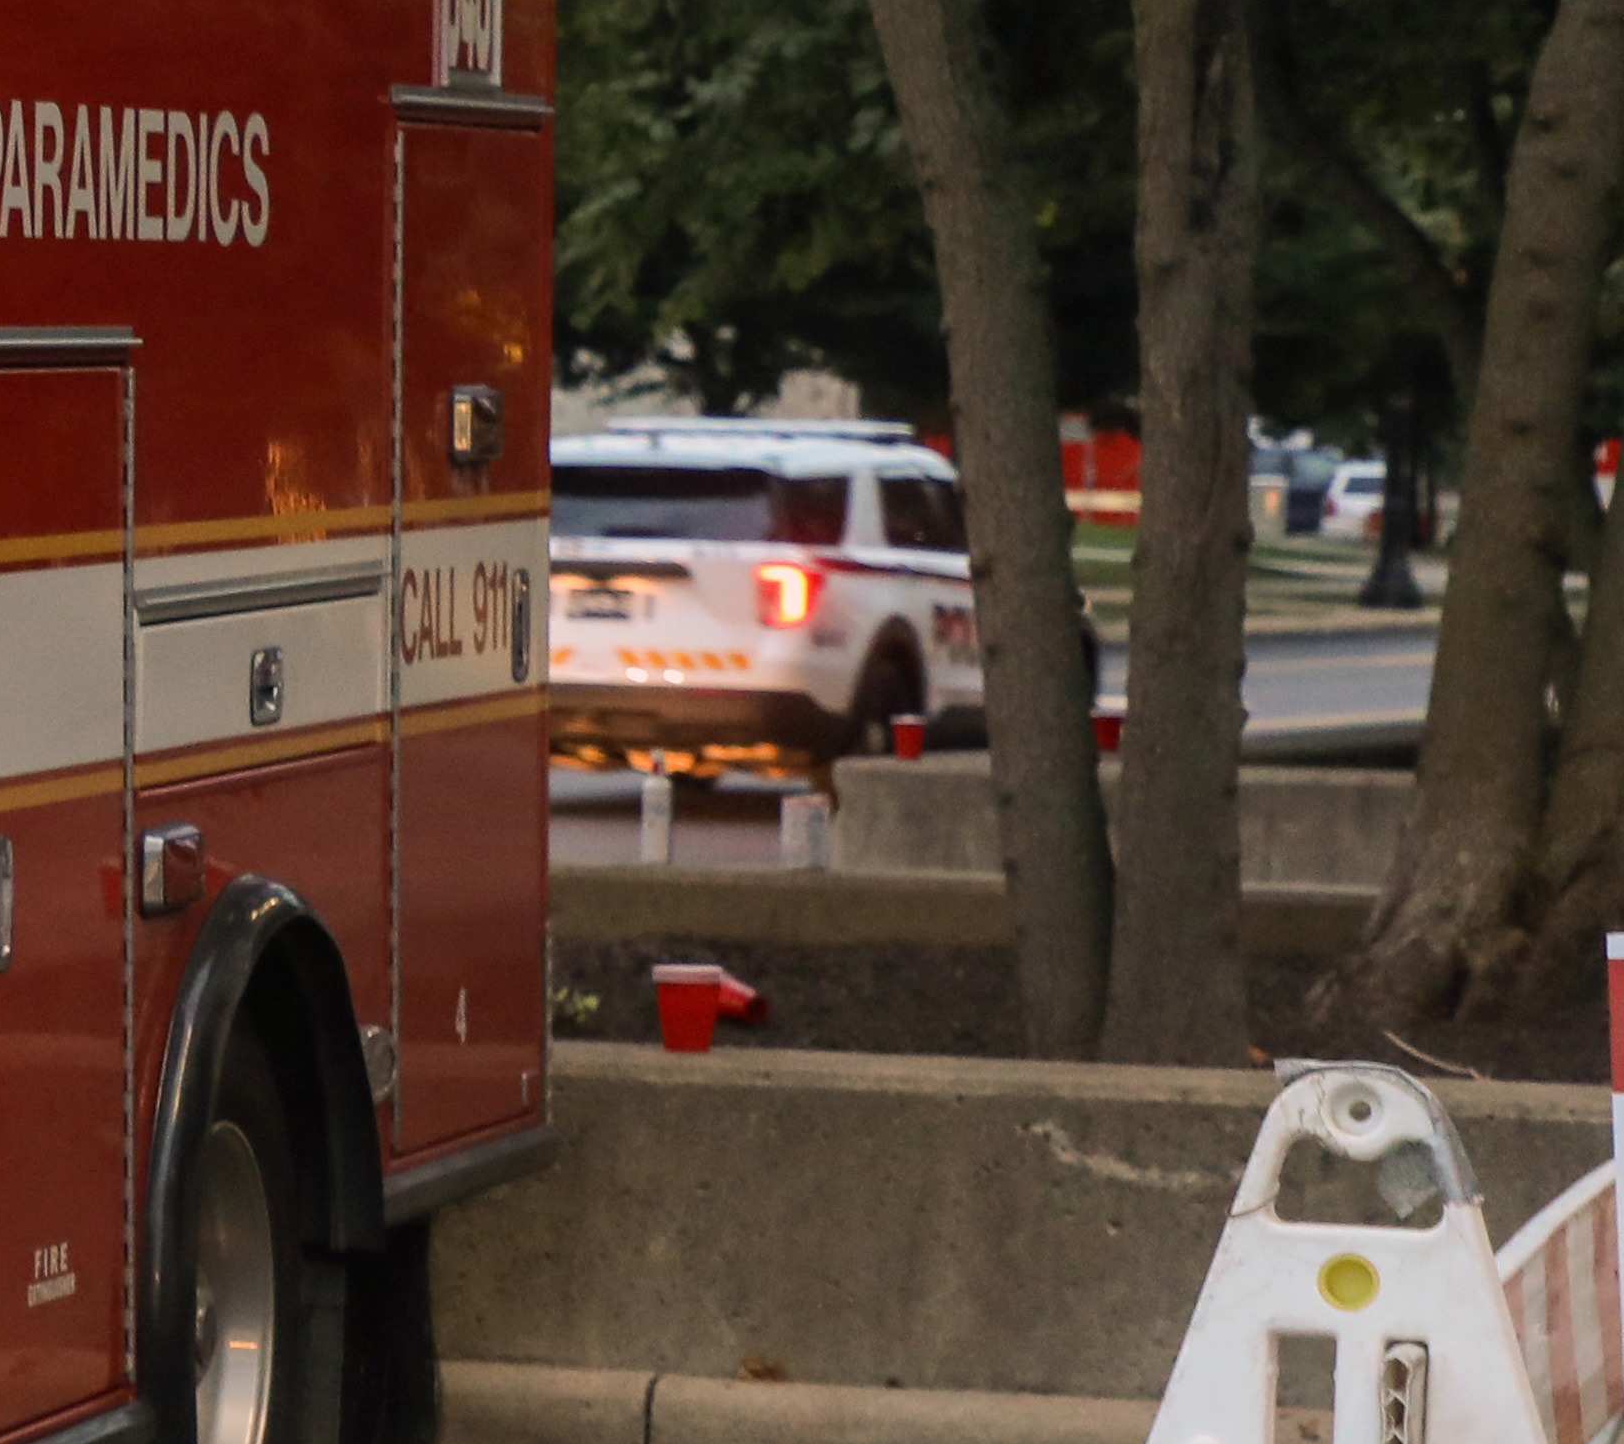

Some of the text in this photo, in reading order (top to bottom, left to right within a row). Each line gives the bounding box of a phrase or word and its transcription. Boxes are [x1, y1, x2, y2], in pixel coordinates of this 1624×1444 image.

[400, 560, 508, 665] CALL 911
[34, 1241, 69, 1279] FIRE
